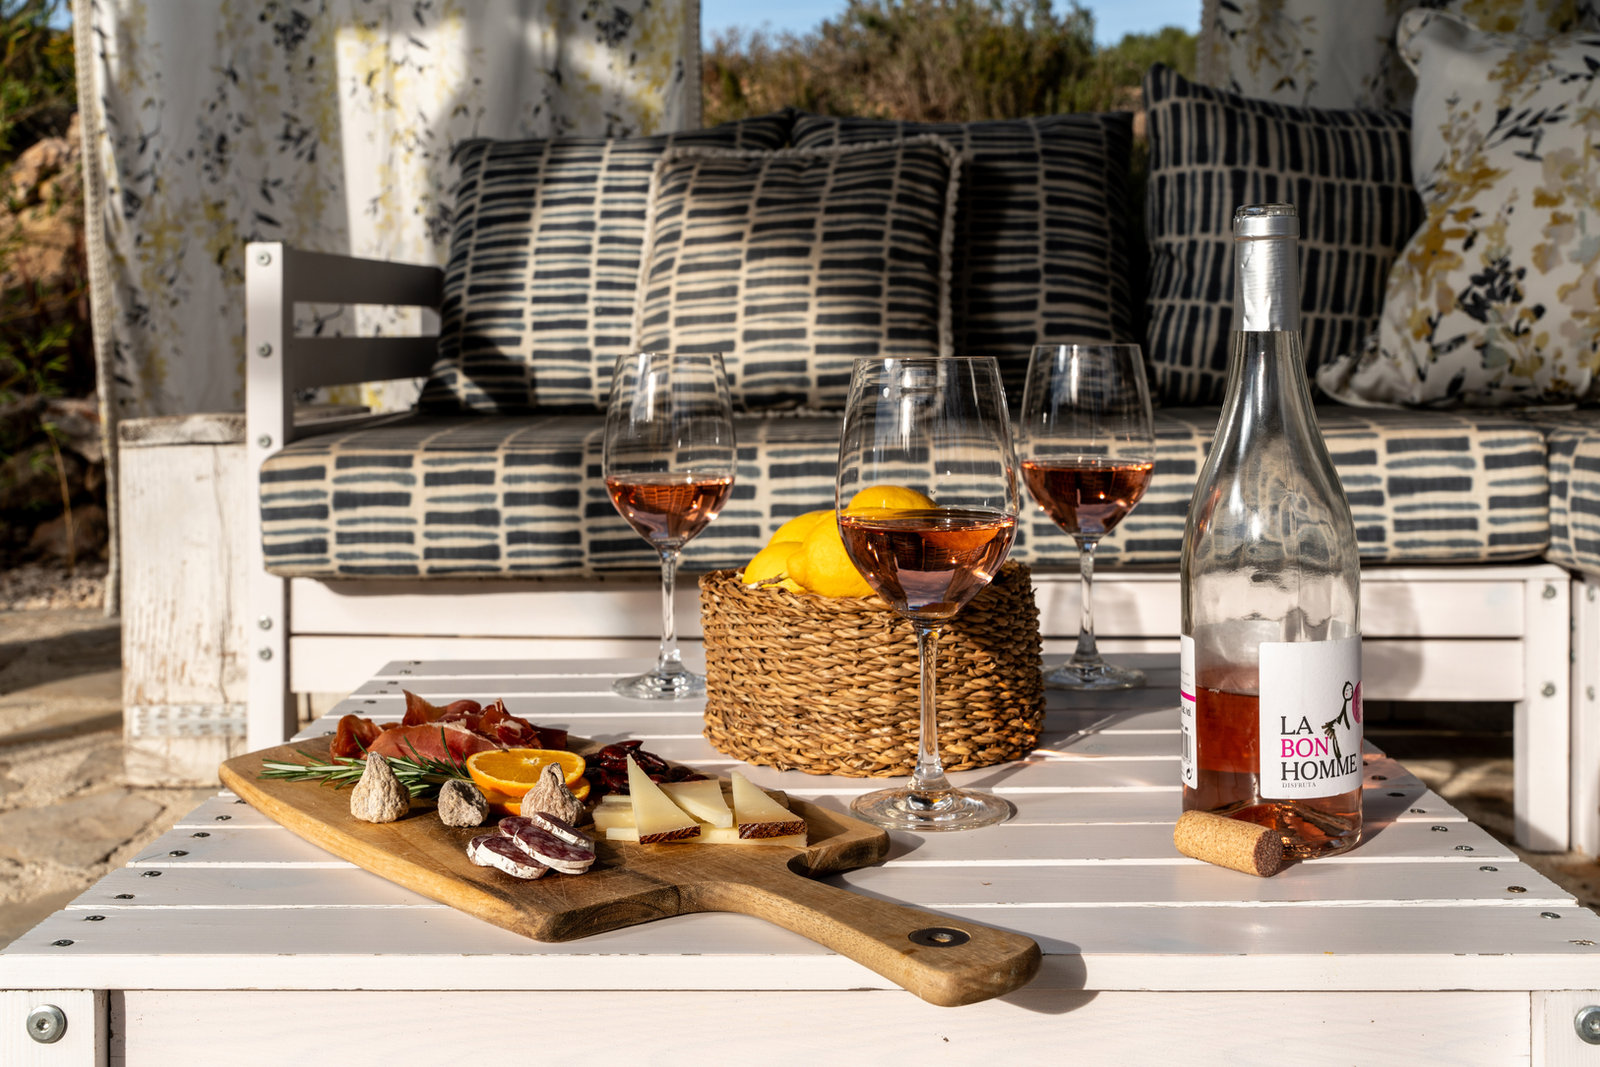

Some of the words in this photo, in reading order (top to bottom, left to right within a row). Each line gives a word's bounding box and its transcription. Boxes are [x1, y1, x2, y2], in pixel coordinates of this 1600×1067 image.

[1281, 715, 1314, 735] LA
[1281, 737, 1329, 758] BON
[1281, 753, 1358, 781] HOMME
